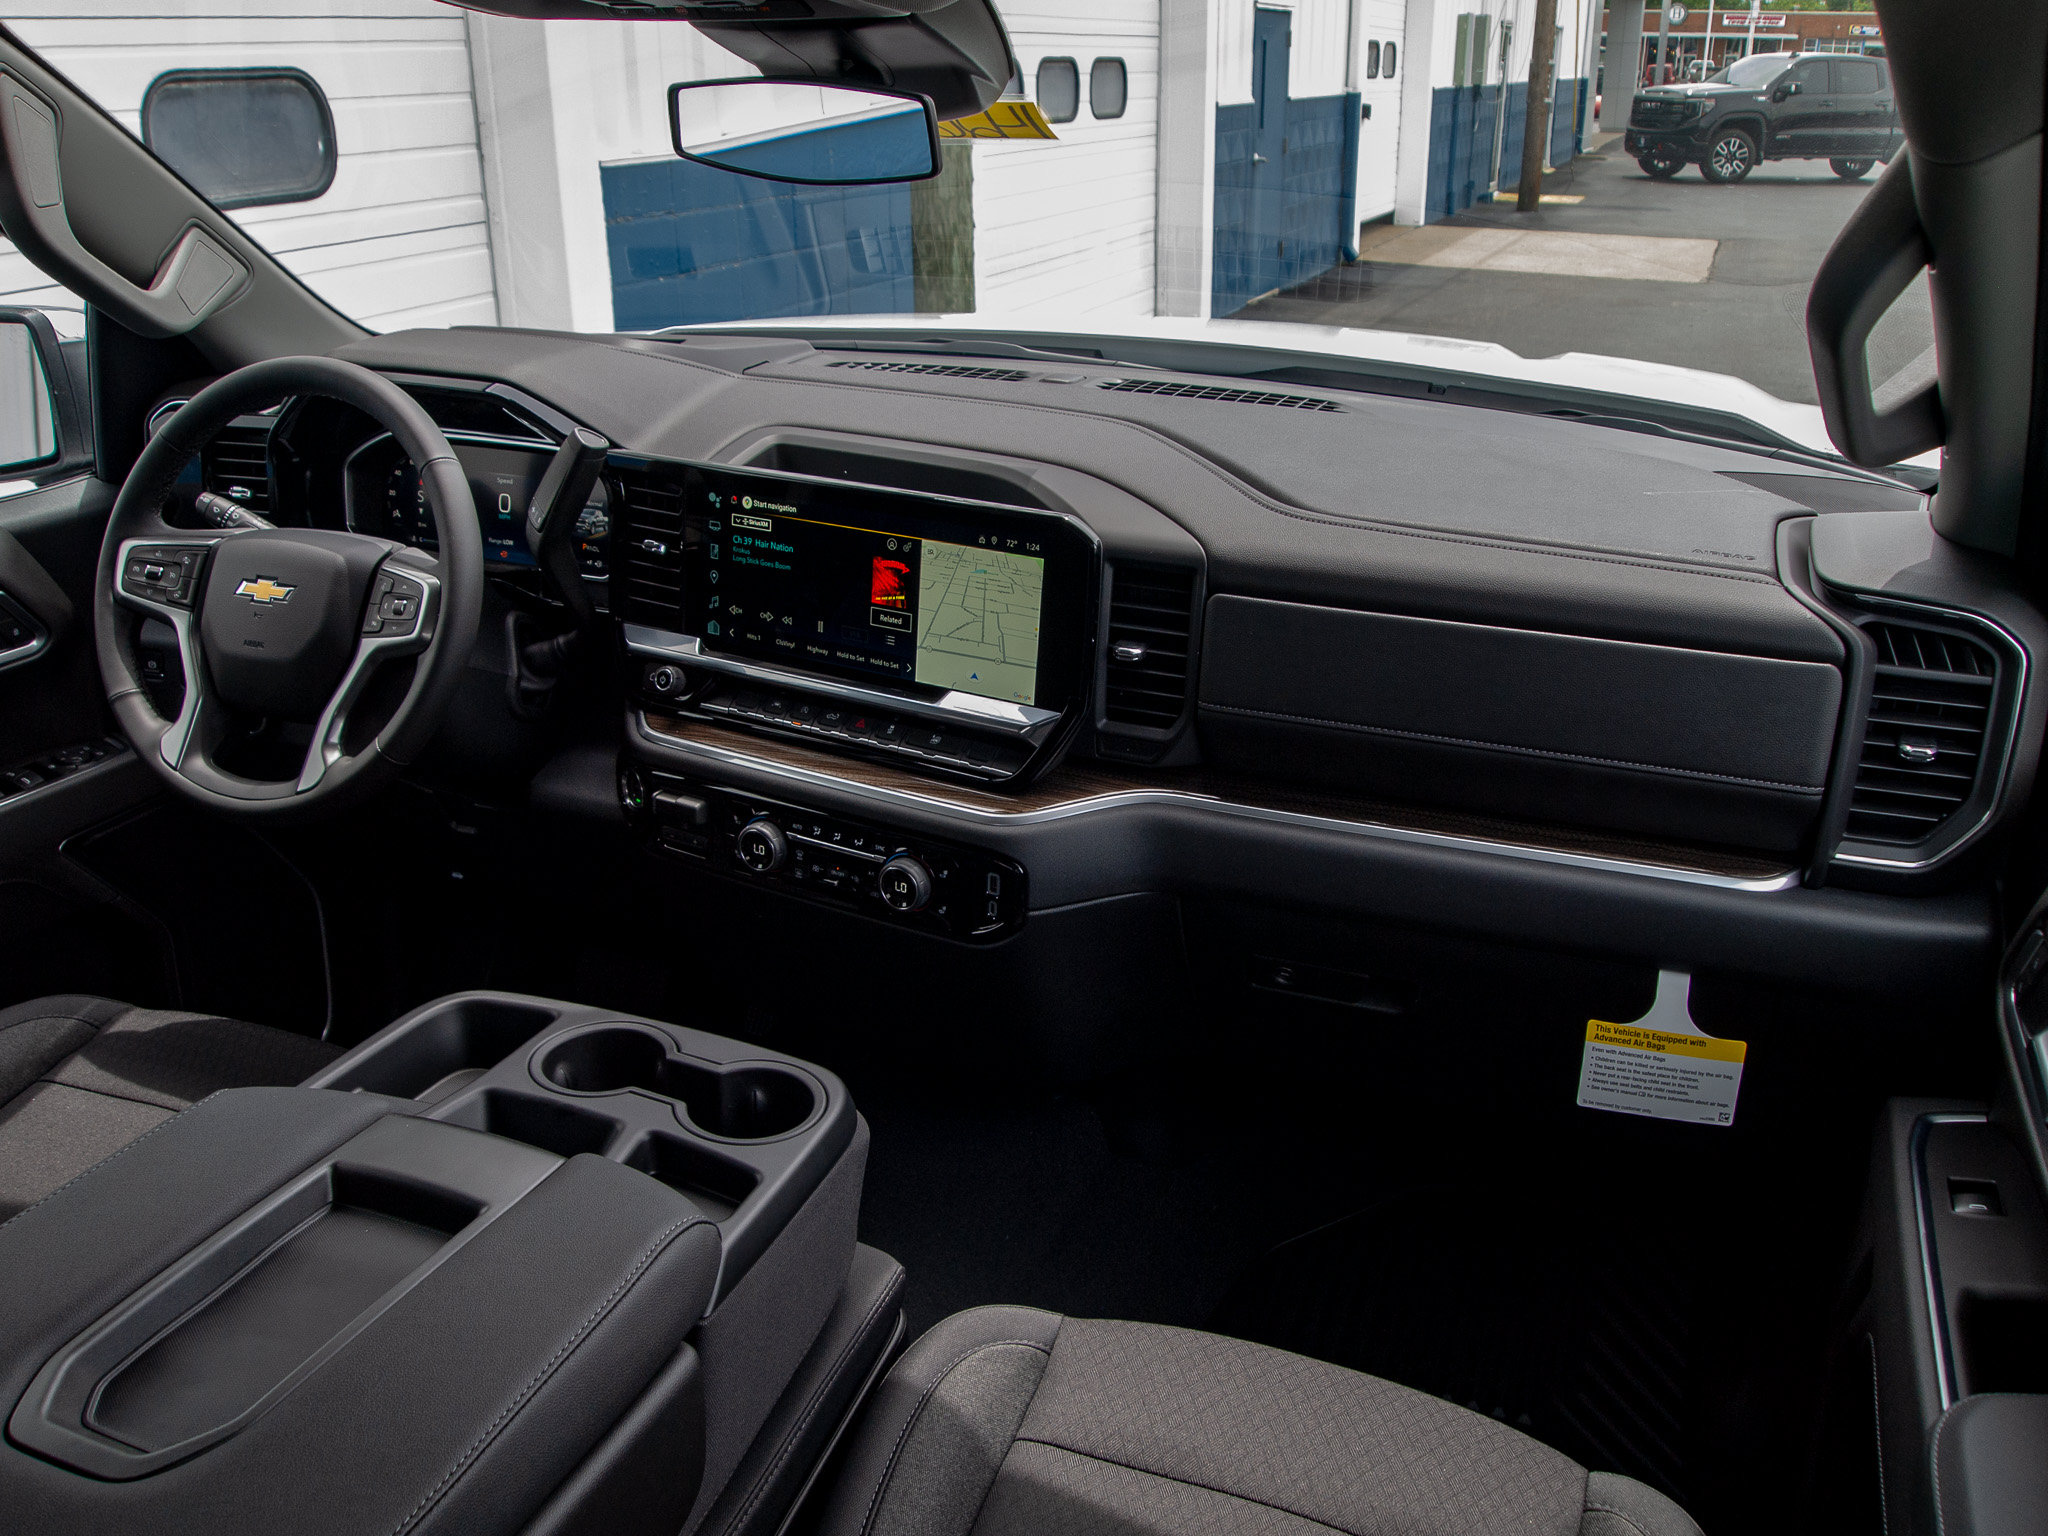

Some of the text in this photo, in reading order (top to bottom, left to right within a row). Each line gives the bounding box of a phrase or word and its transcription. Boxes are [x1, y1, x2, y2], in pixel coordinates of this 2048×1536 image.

[498, 493, 511, 513] 0
[753, 499, 797, 513] Start navigation
[732, 535, 794, 553] Ch 39 Hair Nation
[1026, 543, 1040, 551] 1:24
[732, 554, 792, 571] Long Stick Goes Boom
[880, 614, 903, 625] Related
[807, 645, 829, 656] Highway
[837, 651, 849, 660] Hold
[856, 654, 865, 662] Set
[870, 657, 883, 666] Hold
[890, 661, 899, 669] Set
[1593, 1032, 1666, 1051] Advanced Air Bags
[1595, 1024, 1707, 1047] This Vehicle is Equipped with
[1617, 1050, 1643, 1058] Advanced
[1594, 1055, 1615, 1063] Children
[1655, 1064, 1678, 1073] seriously
[1679, 1068, 1697, 1076] injured
